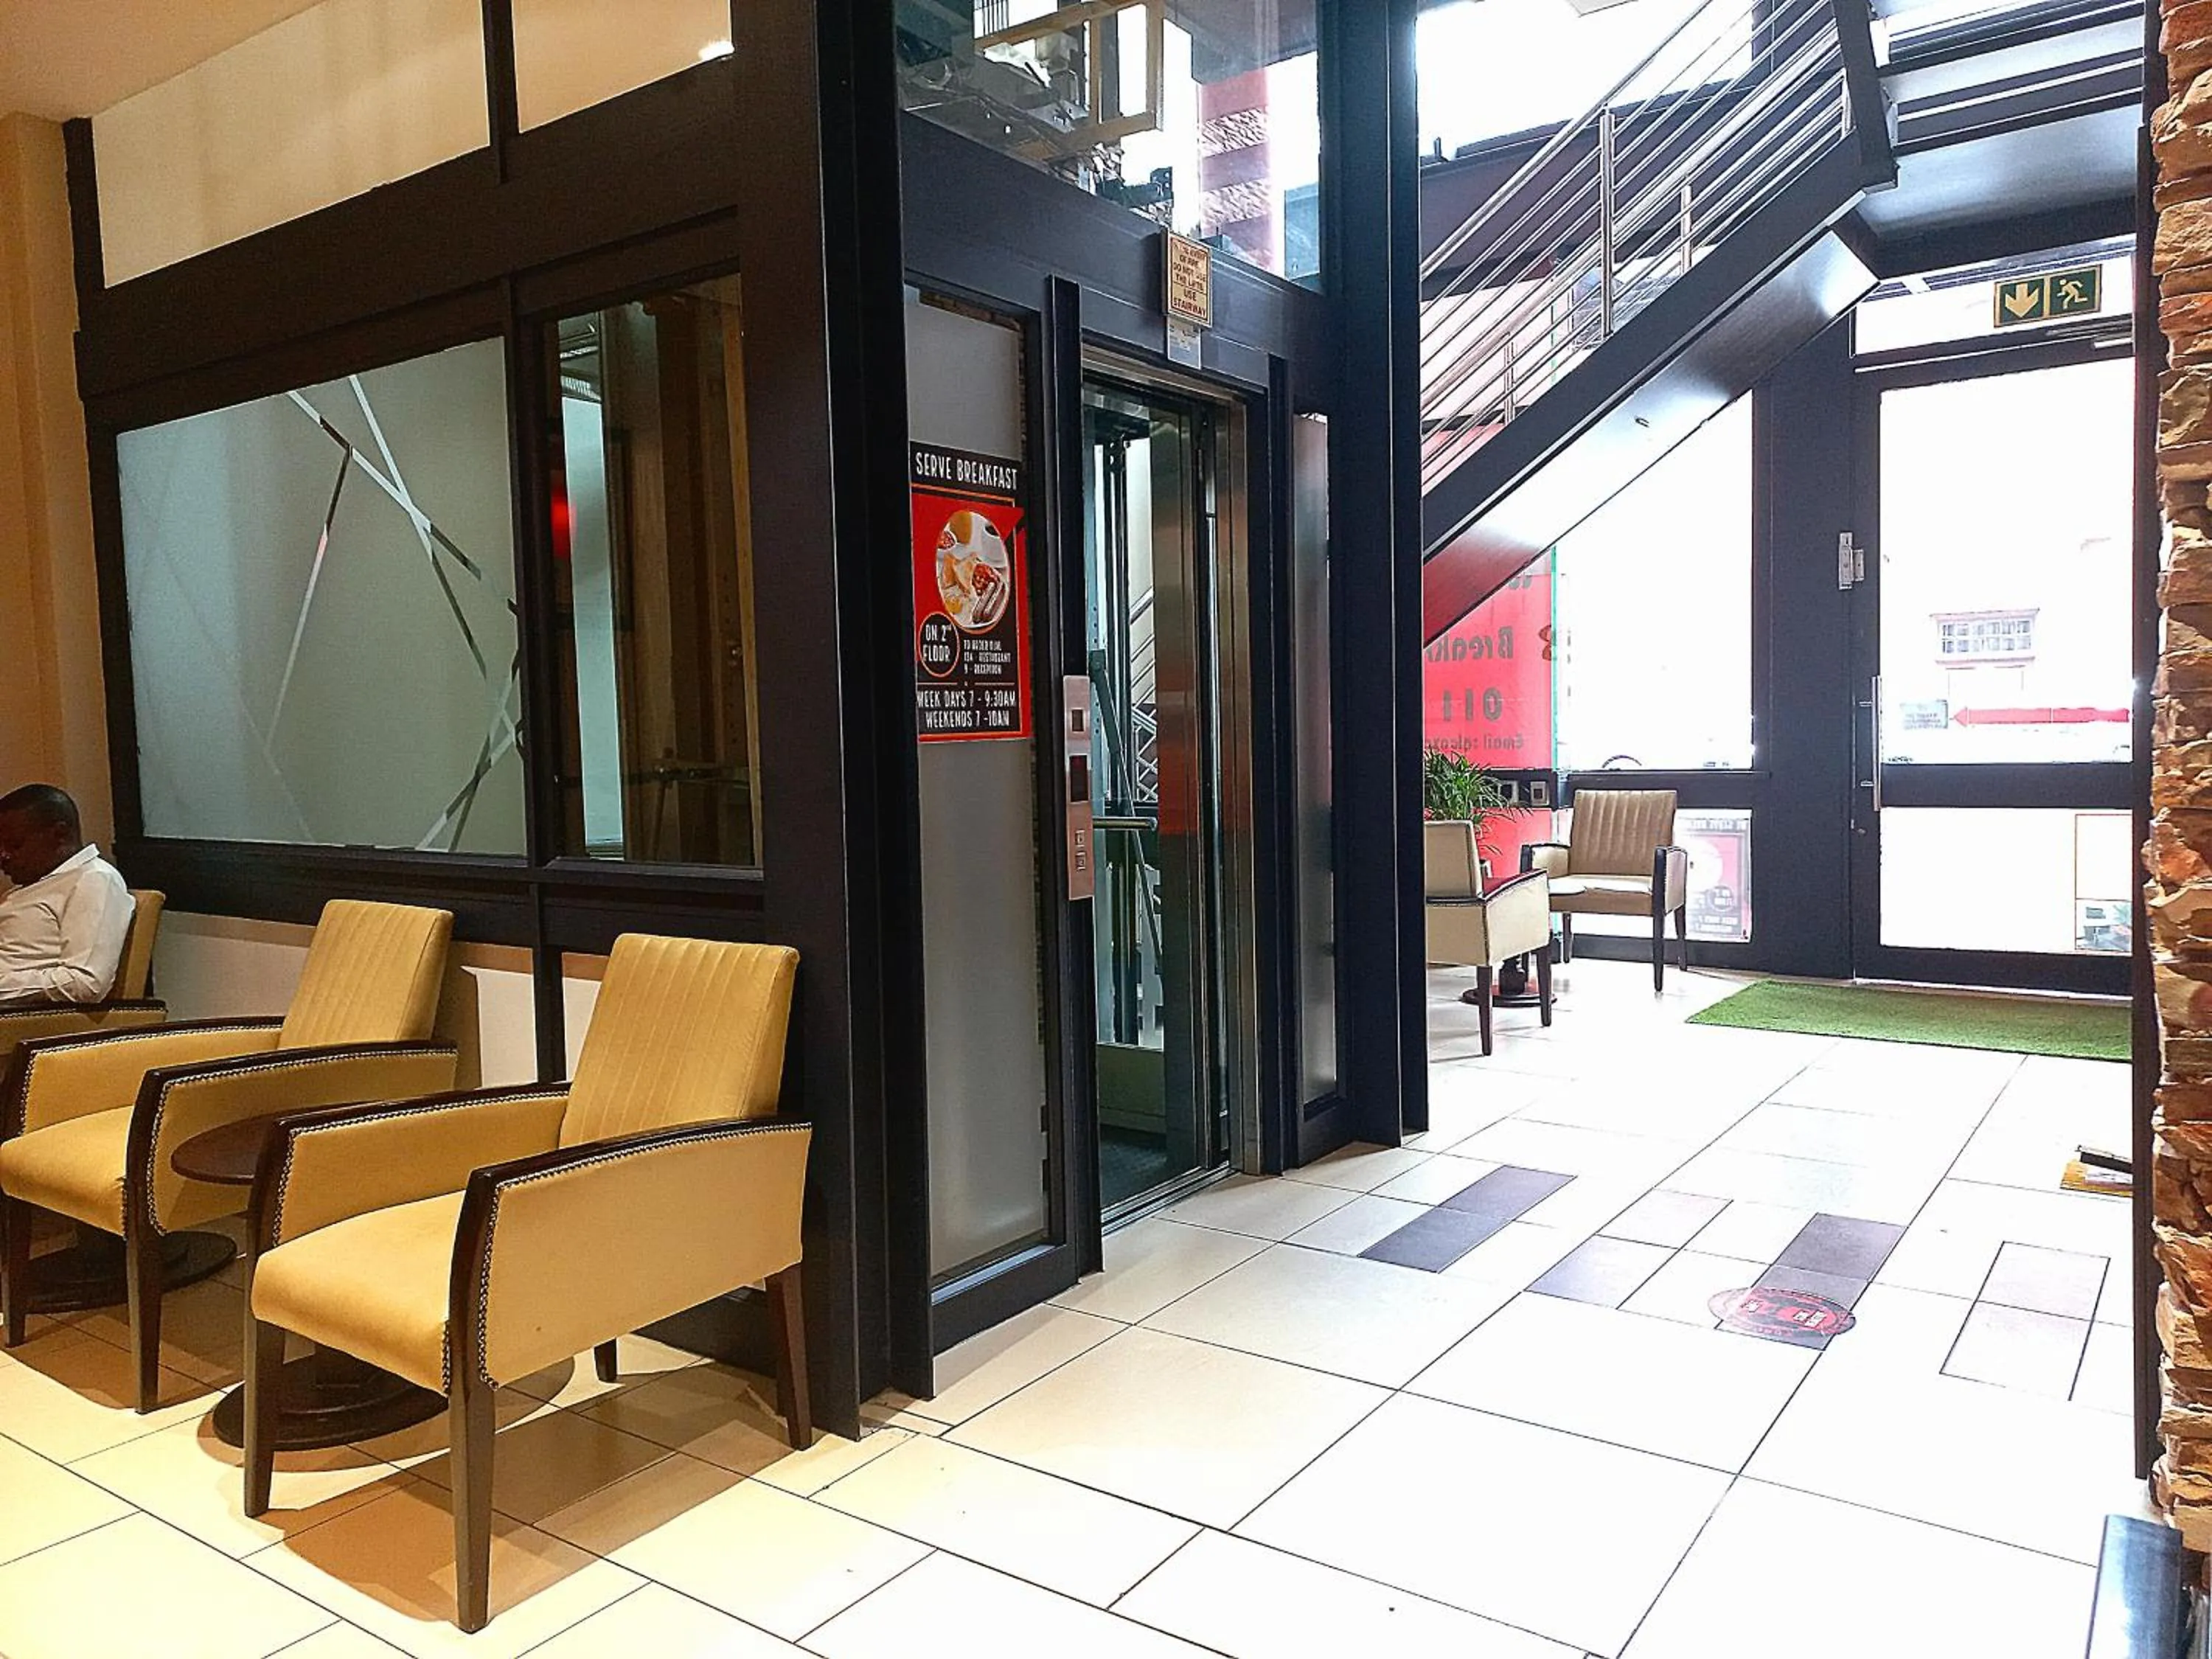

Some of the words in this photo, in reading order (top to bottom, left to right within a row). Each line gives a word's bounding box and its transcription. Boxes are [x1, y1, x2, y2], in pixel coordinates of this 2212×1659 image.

[1183, 290, 1197, 302] USE
[1173, 298, 1206, 317] STAIRWAY
[916, 452, 952, 480] SERVE
[957, 459, 1018, 491] BREAKFAST
[925, 625, 937, 641] ON
[922, 644, 951, 663] FLOOR
[917, 689, 941, 708] WEEK
[945, 690, 967, 708] DAYS
[969, 691, 974, 707] 7
[984, 690, 1017, 708] 9:30AM
[925, 710, 973, 728] WEEKENDS
[975, 711, 981, 728] 7
